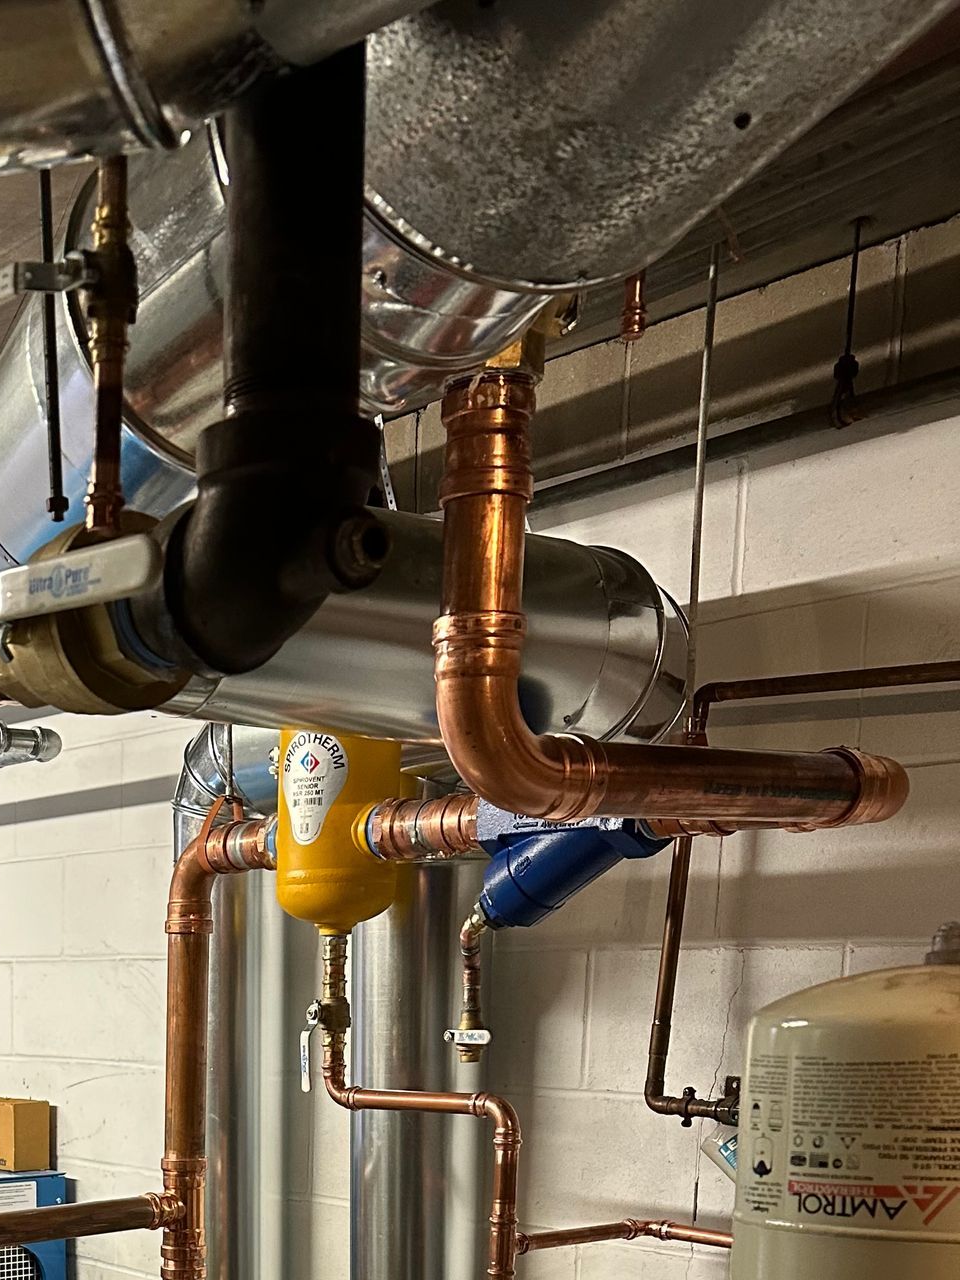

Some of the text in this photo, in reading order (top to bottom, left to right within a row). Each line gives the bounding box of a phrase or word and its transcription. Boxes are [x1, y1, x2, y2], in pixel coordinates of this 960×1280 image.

[285, 734, 345, 773] SPIROTHERM
[297, 782, 319, 790] SENIOR
[793, 1193, 907, 1220] AMTROL
